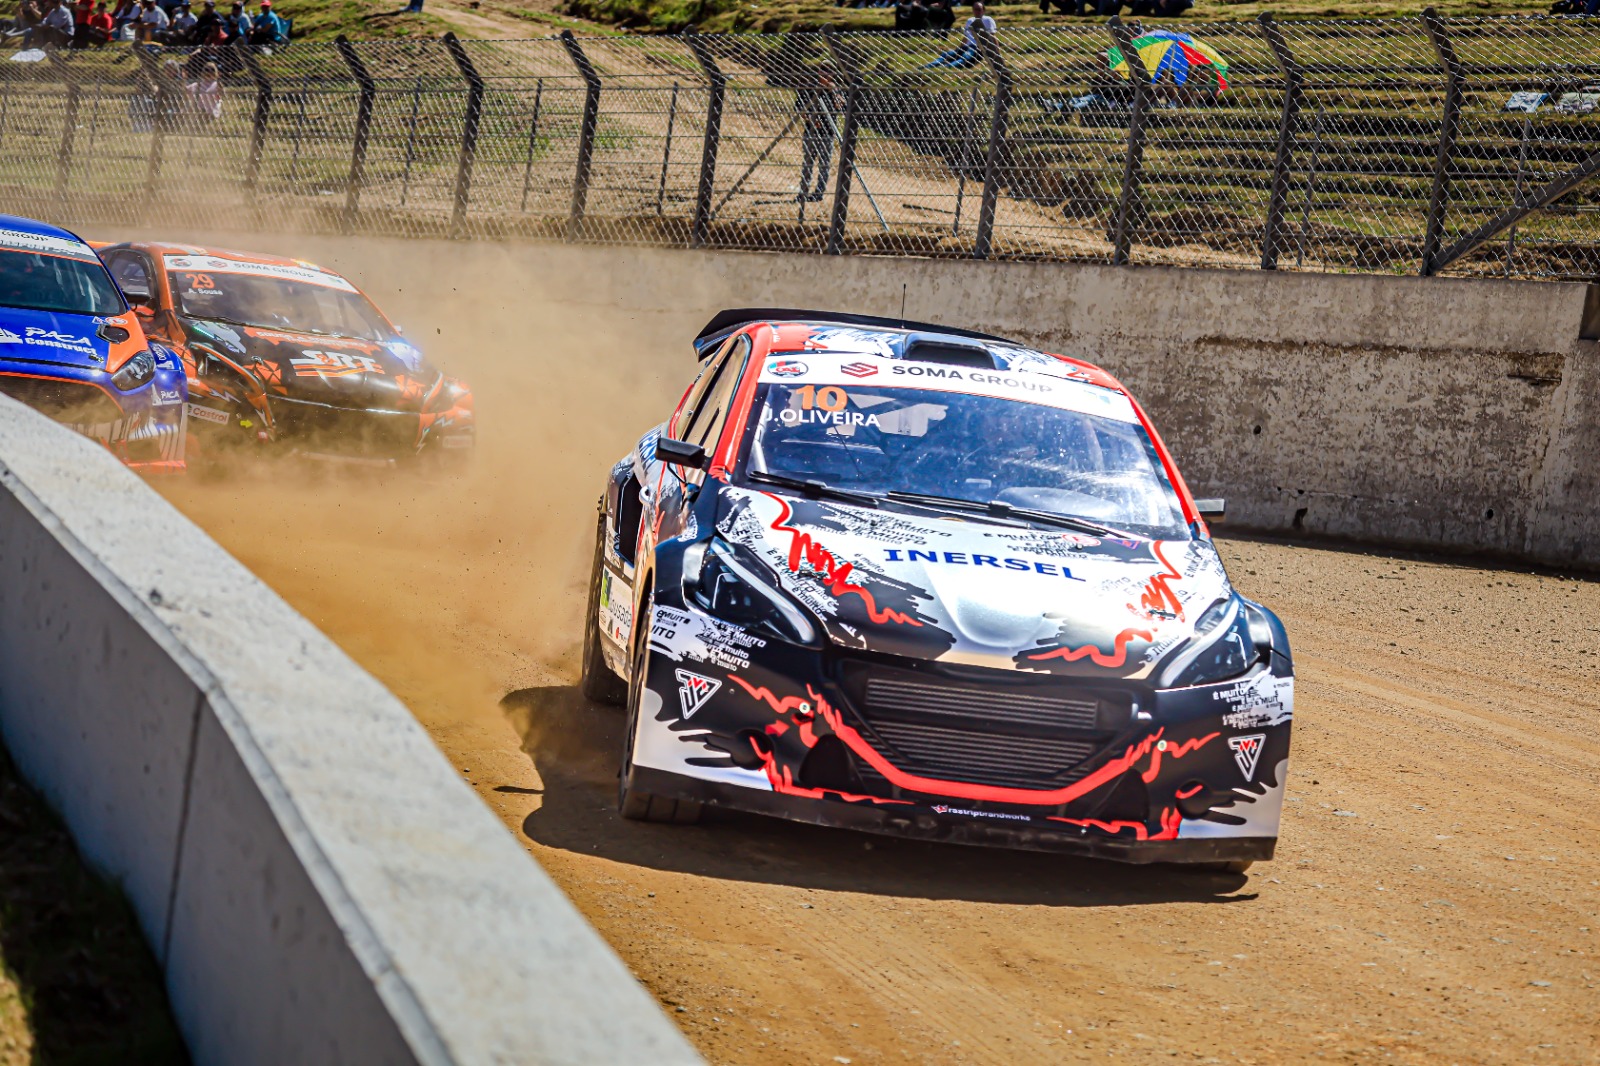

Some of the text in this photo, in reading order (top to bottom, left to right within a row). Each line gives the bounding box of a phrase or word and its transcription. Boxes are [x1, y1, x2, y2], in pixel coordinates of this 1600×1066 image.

[1, 230, 49, 241] GROUP
[233, 262, 315, 278] SOMA GROUP
[186, 273, 215, 289] 29
[25, 327, 92, 347] PACA
[25, 338, 98, 356] Construct
[892, 365, 1053, 393] SOMA GROUP
[796, 384, 848, 412] 10
[193, 407, 227, 422] Castrol
[766, 408, 881, 427] J.OLIVEIRA
[883, 549, 1087, 583] INERSEL
